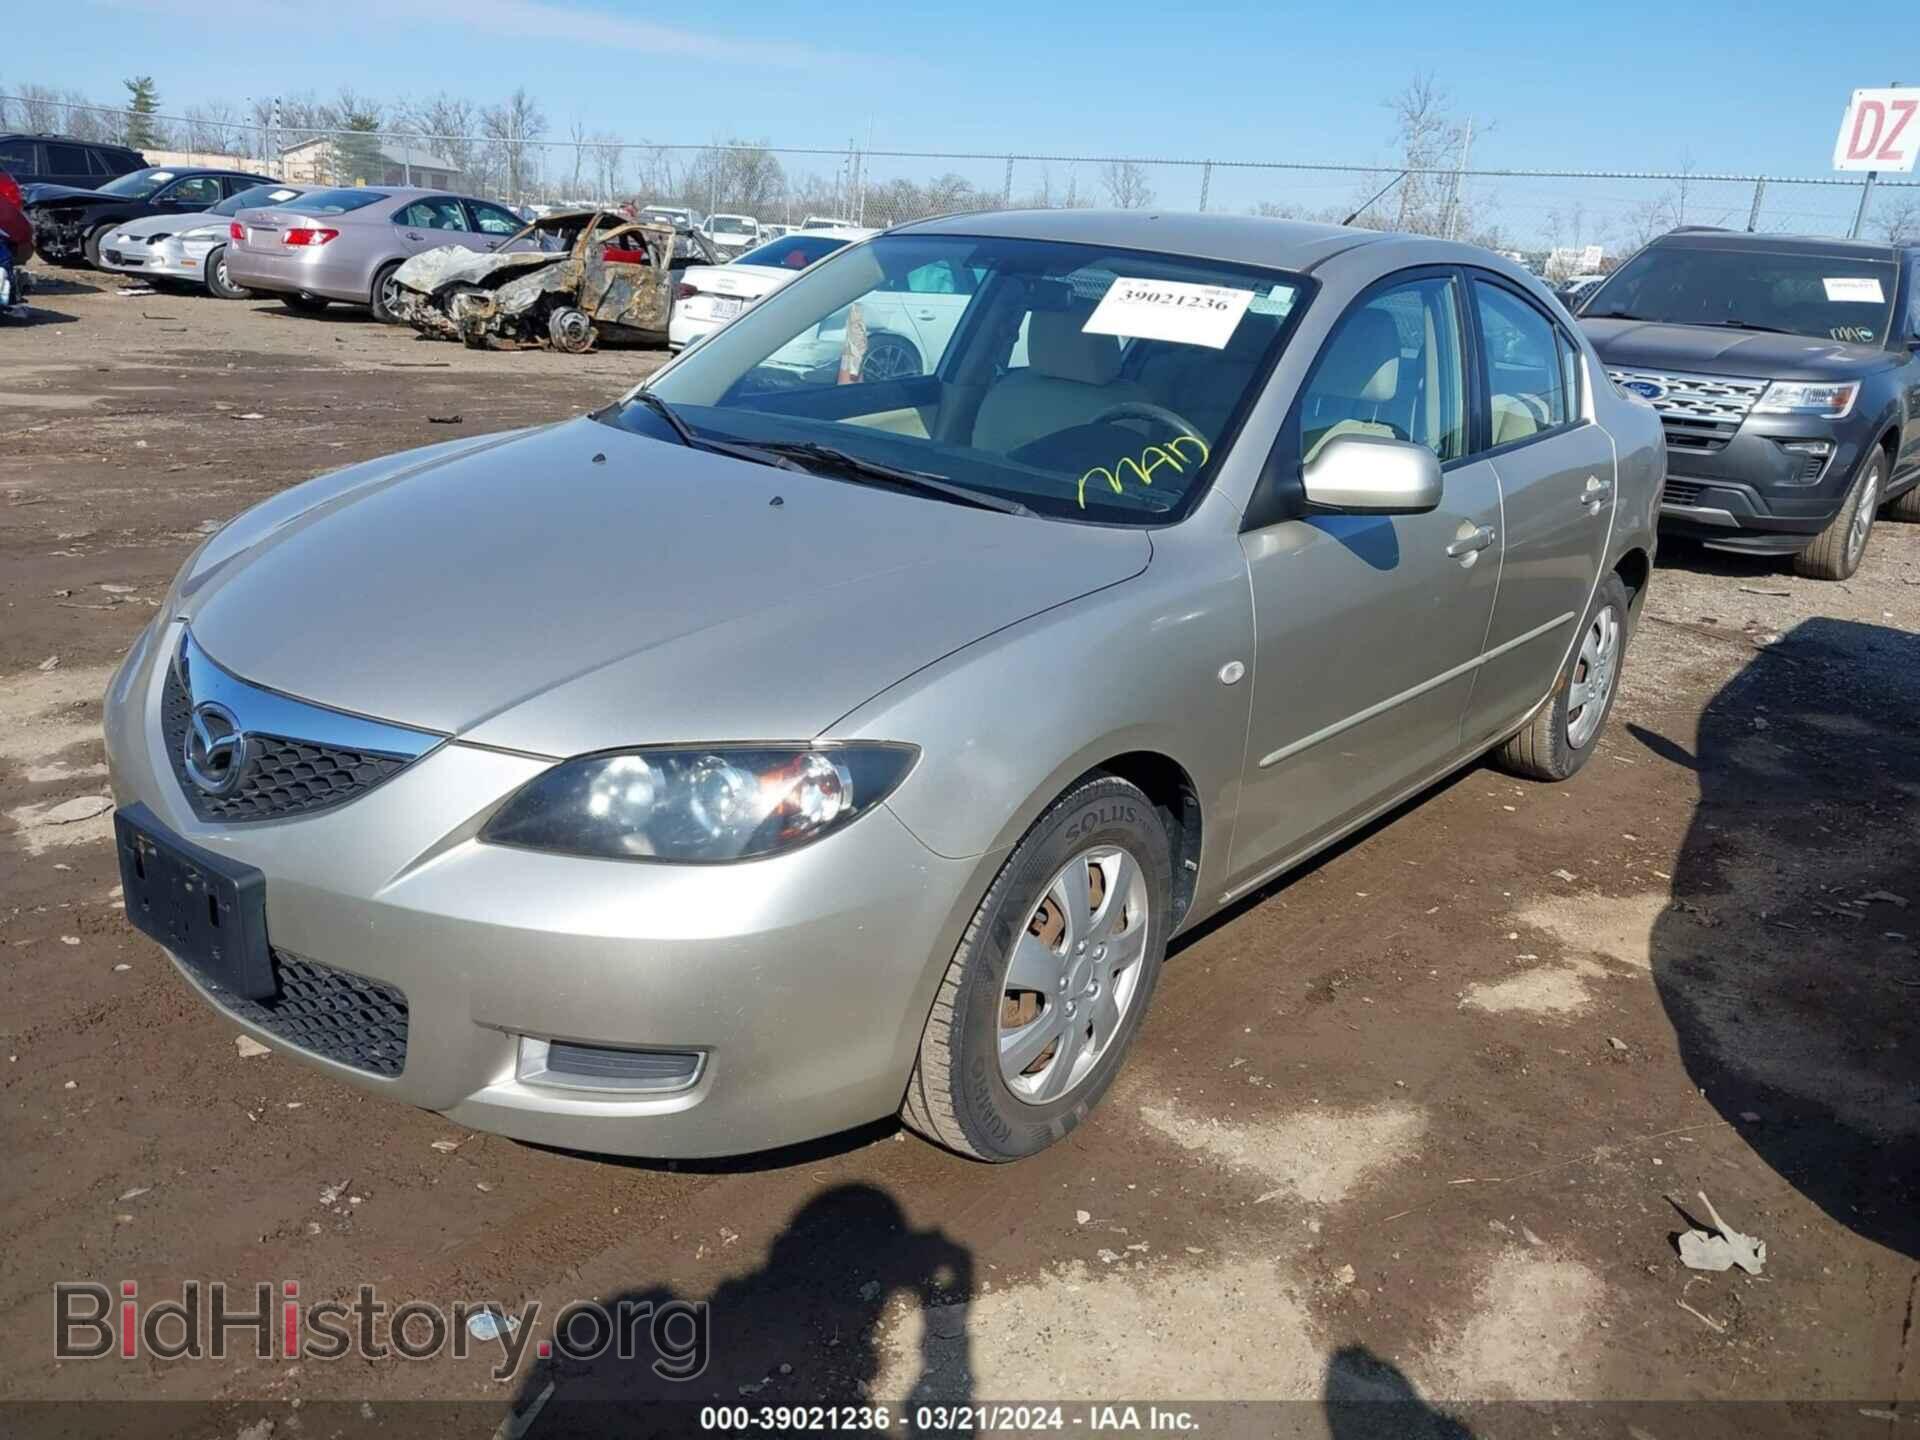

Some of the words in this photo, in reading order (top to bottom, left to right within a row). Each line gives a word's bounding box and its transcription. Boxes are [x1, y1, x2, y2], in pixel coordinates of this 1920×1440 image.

[1846, 100, 1919, 160] DZ
[1119, 289, 1228, 311] 39021236
[1065, 805, 1137, 845] SOLUS
